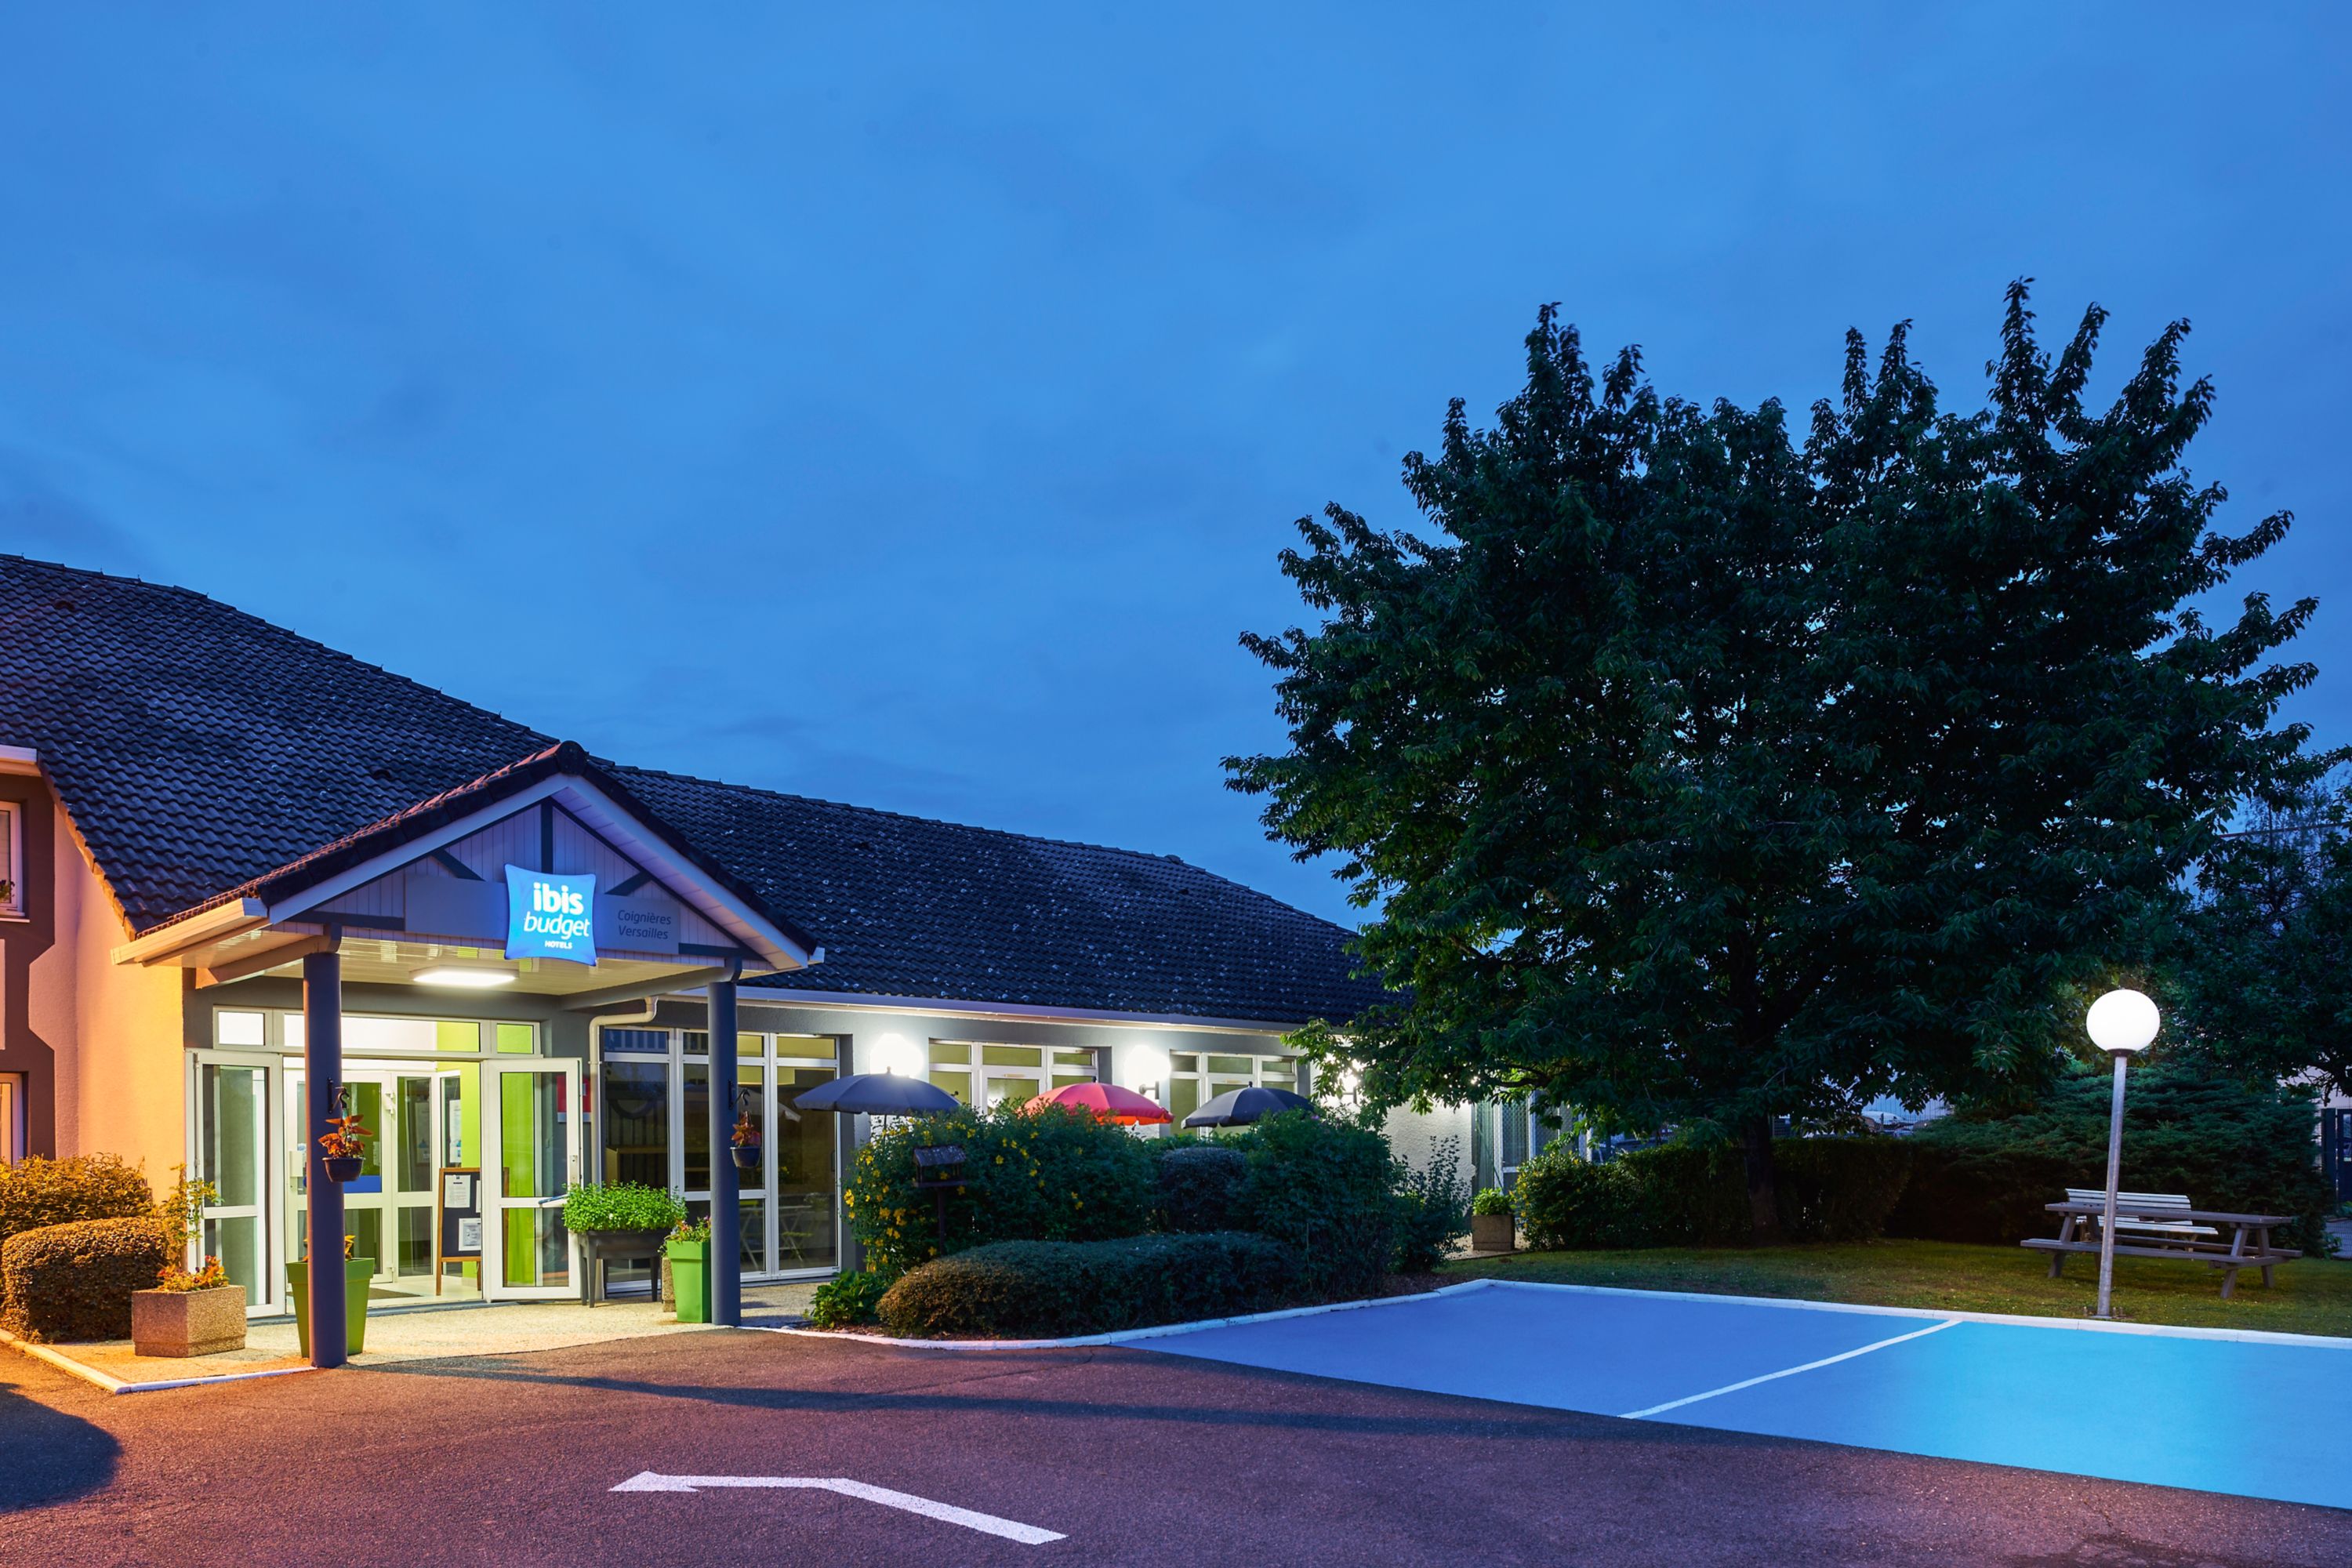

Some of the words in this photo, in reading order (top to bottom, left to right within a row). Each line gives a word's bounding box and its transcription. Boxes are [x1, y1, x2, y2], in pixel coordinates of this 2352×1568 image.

[533, 882, 584, 915] ibis
[523, 911, 590, 939] budget
[618, 909, 672, 925] Coignières
[619, 925, 669, 939] Versailles
[544, 940, 573, 949] HOTELS
